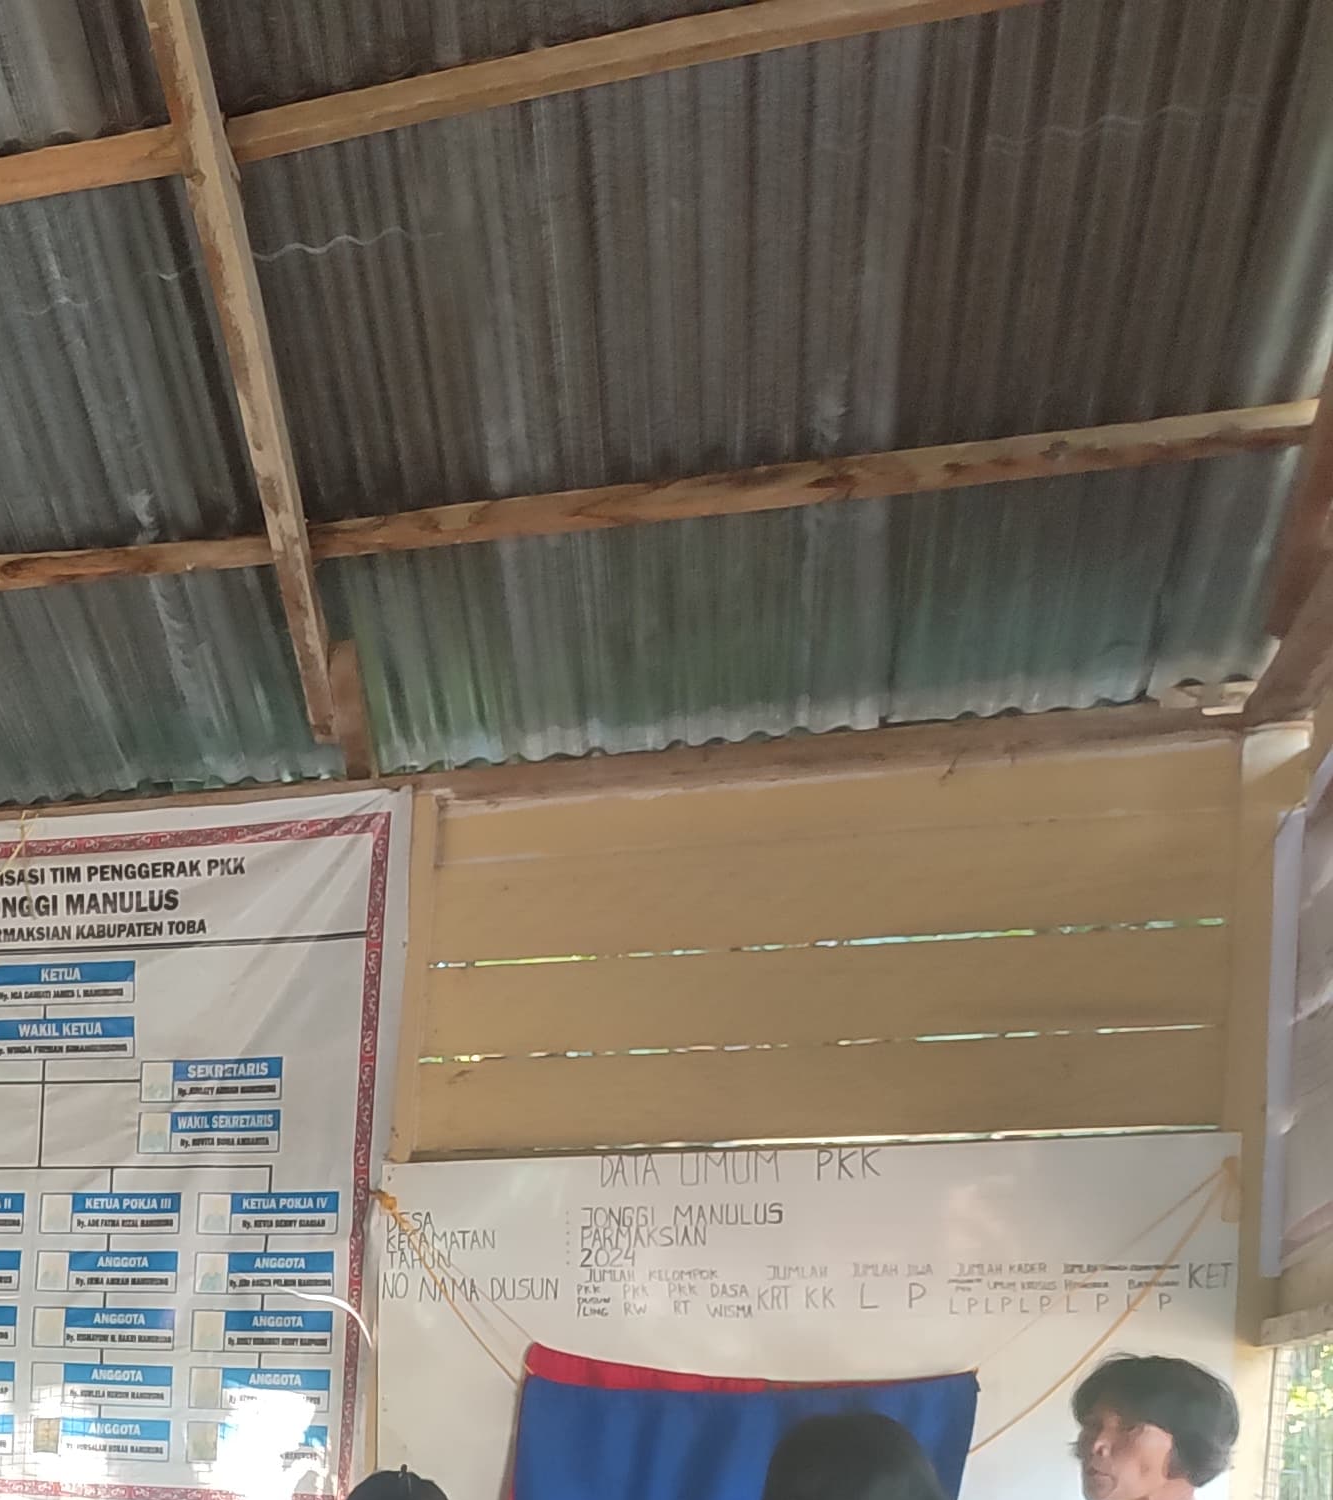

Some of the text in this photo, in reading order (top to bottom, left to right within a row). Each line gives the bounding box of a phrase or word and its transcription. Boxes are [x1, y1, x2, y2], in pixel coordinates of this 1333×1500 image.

[50, 866, 82, 885] TIM
[87, 860, 203, 884] PENGGERAK
[207, 856, 245, 877] PKK
[67, 888, 179, 916] MANULUS
[76, 922, 163, 940] KABUPATEN
[167, 919, 207, 936] TOBA
[40, 967, 81, 983] KETUA
[19, 1022, 103, 1037] WAKIL KETUA
[187, 1062, 269, 1078] SEKRETARIS
[178, 1114, 274, 1129] WAKIL SEKRETARIS
[599, 1147, 882, 1187] DATA UMUM PKK
[4, 1198, 12, 1209] II
[85, 1197, 171, 1209] KETUA POKJA III
[242, 1197, 327, 1210] KETUA POKJA IV
[386, 1212, 434, 1233] DESA
[581, 1203, 783, 1228] JONGGI MANULUS
[386, 1230, 496, 1250] KECAMATAN
[580, 1225, 707, 1249] PARMAKSIAN
[97, 1256, 149, 1268] ANGGOTA
[254, 1257, 305, 1269] ANGGOTA
[388, 1251, 452, 1269] TAHUN
[580, 1248, 636, 1267] 2024
[584, 1268, 635, 1283] JUMLAH
[766, 1265, 829, 1281] JUMLAH
[1188, 1262, 1233, 1289] KET
[383, 1272, 559, 1302] NO NAMA DUSUN
[710, 1284, 748, 1298] DASA
[757, 1286, 792, 1311] KRT
[805, 1286, 836, 1310] KK
[860, 1282, 879, 1309] L
[908, 1282, 927, 1309] P
[1096, 1293, 1109, 1311] P
[1159, 1293, 1172, 1311] P
[673, 1300, 690, 1315] RT
[949, 1298, 959, 1315] L
[967, 1297, 978, 1313] P
[985, 1297, 995, 1313] L
[1001, 1297, 1012, 1312] P
[1020, 1297, 1030, 1313] L
[1039, 1296, 1051, 1312] P
[1066, 1295, 1079, 1313] L
[93, 1313, 145, 1325] ANGGOTA
[252, 1316, 303, 1328] ANGGOTA
[91, 1369, 143, 1382] ANGGOTA
[249, 1373, 302, 1386] ANGGOTA
[88, 1423, 141, 1436] ANGGOTA
